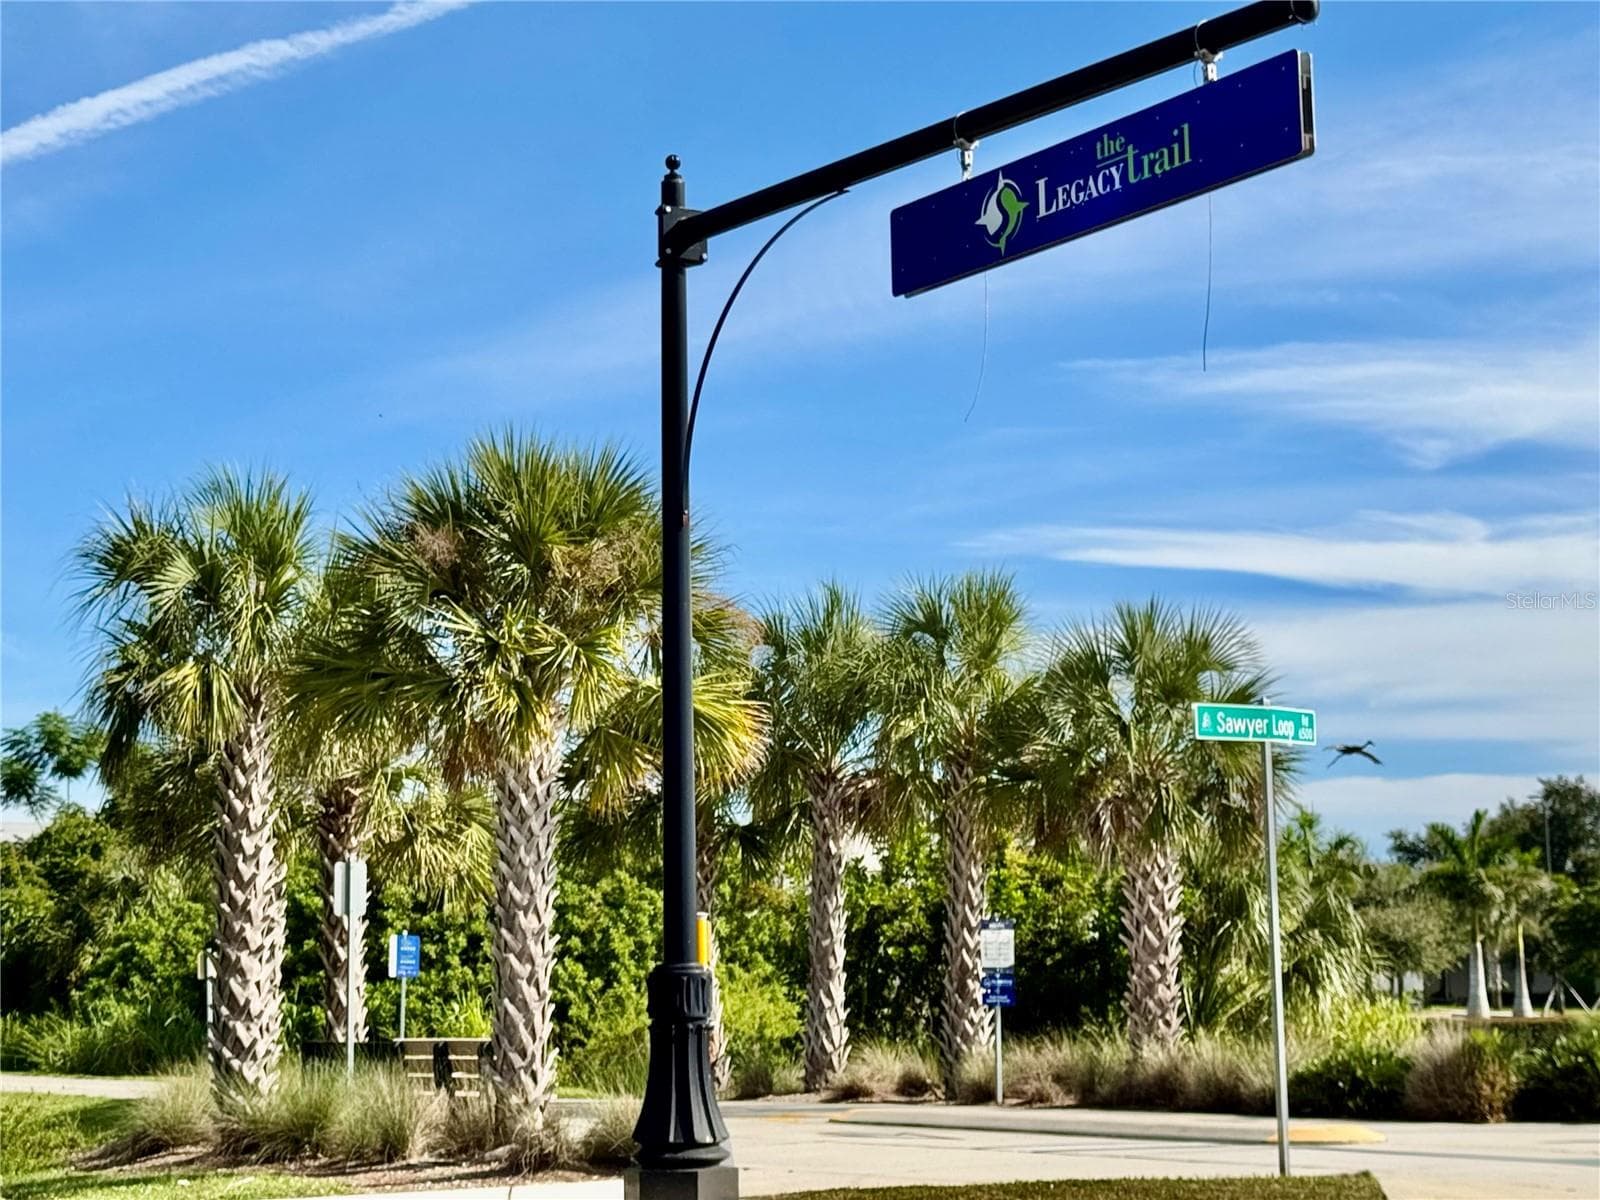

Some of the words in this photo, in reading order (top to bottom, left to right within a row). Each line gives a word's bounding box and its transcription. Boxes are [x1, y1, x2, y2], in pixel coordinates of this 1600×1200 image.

[1095, 132, 1126, 161] the
[1035, 163, 1124, 219] LEGACY
[1126, 122, 1192, 185] trail
[1216, 711, 1269, 740] Sawyer
[1272, 714, 1295, 744] Loop
